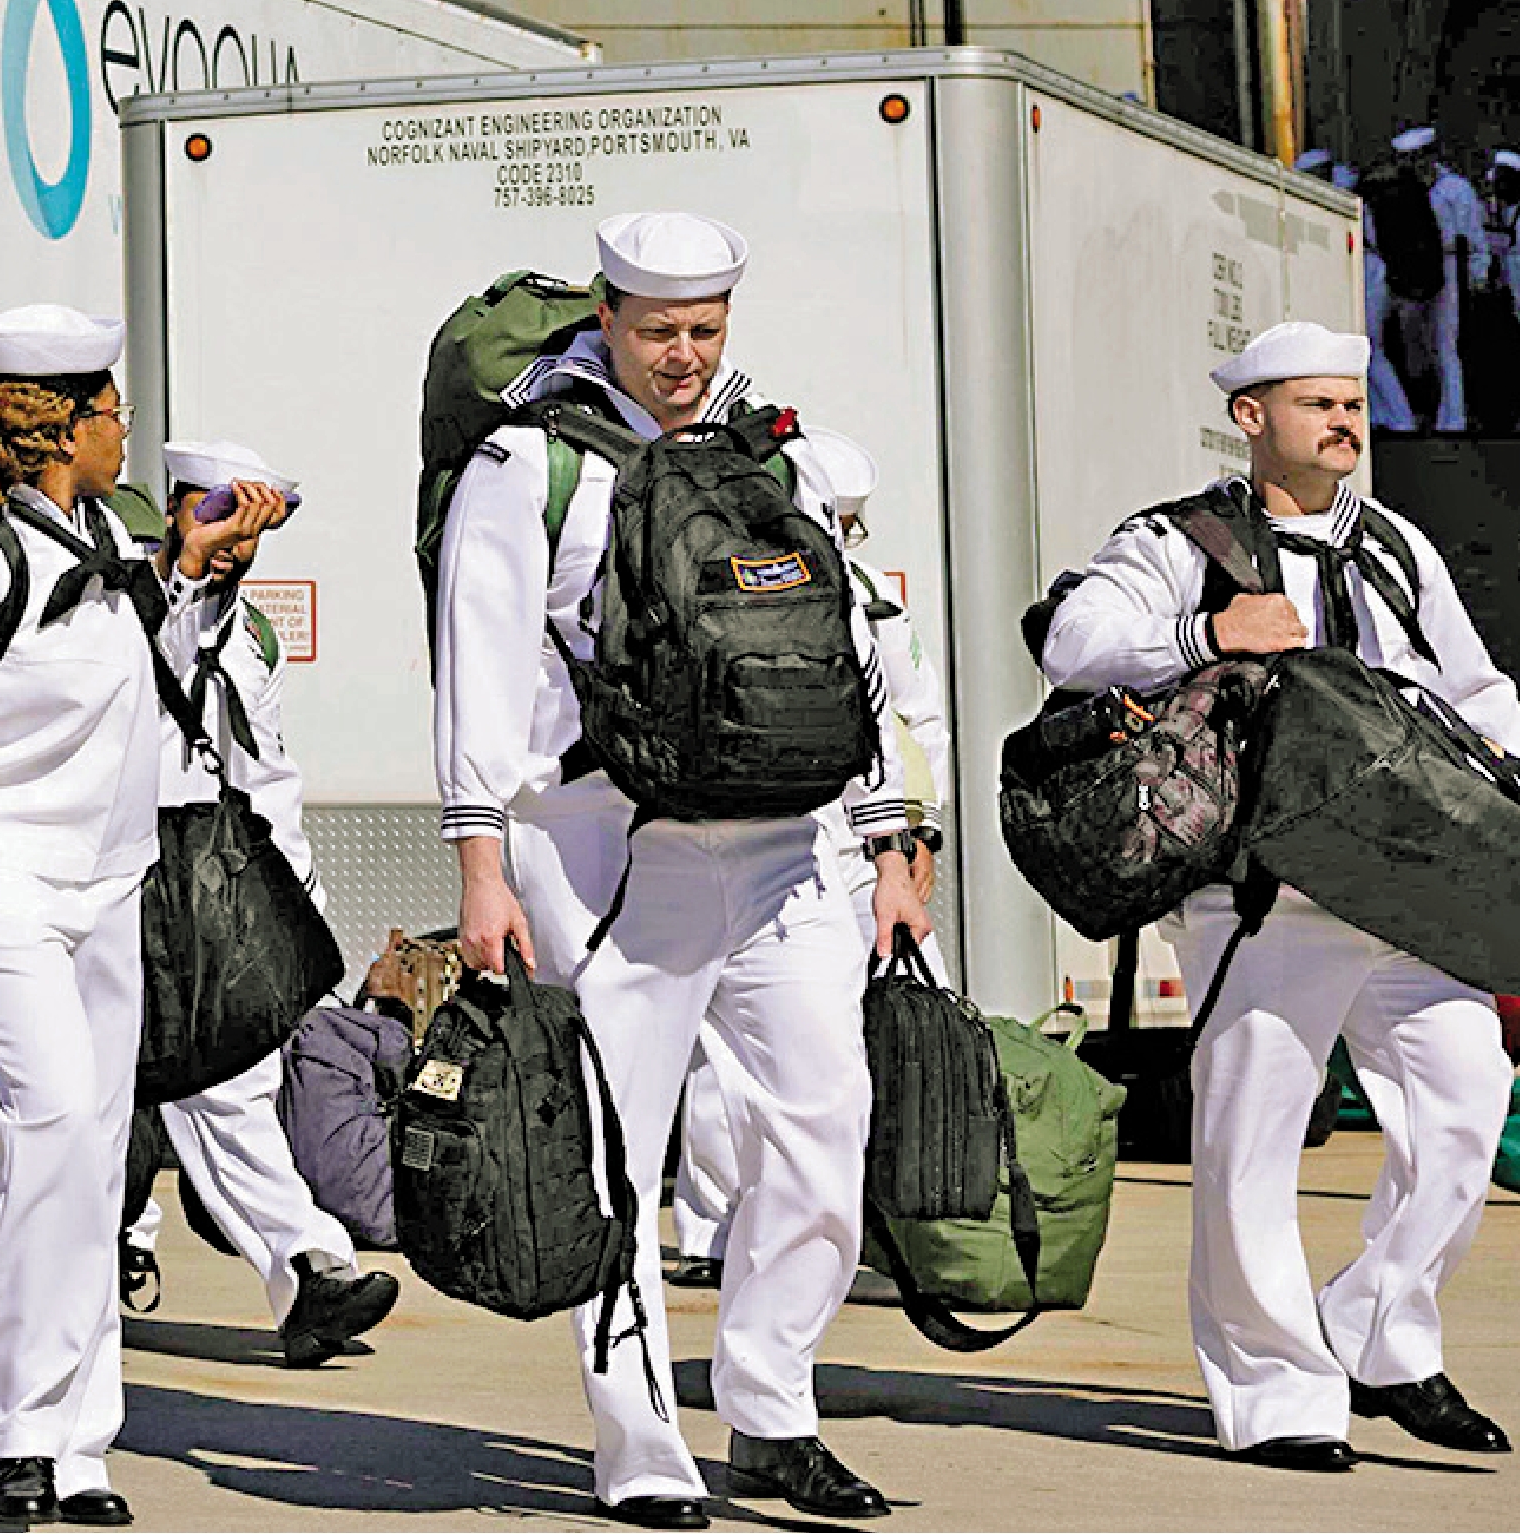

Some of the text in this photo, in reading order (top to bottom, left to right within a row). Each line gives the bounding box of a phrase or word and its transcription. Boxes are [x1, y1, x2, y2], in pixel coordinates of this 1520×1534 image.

[382, 105, 722, 141] COGNIZANT ENGINEERING ORGANIZATION
[367, 143, 444, 166] NORFOLK
[449, 140, 500, 162] NAVAL
[727, 127, 751, 150] VA
[496, 160, 583, 185] CODE 2310
